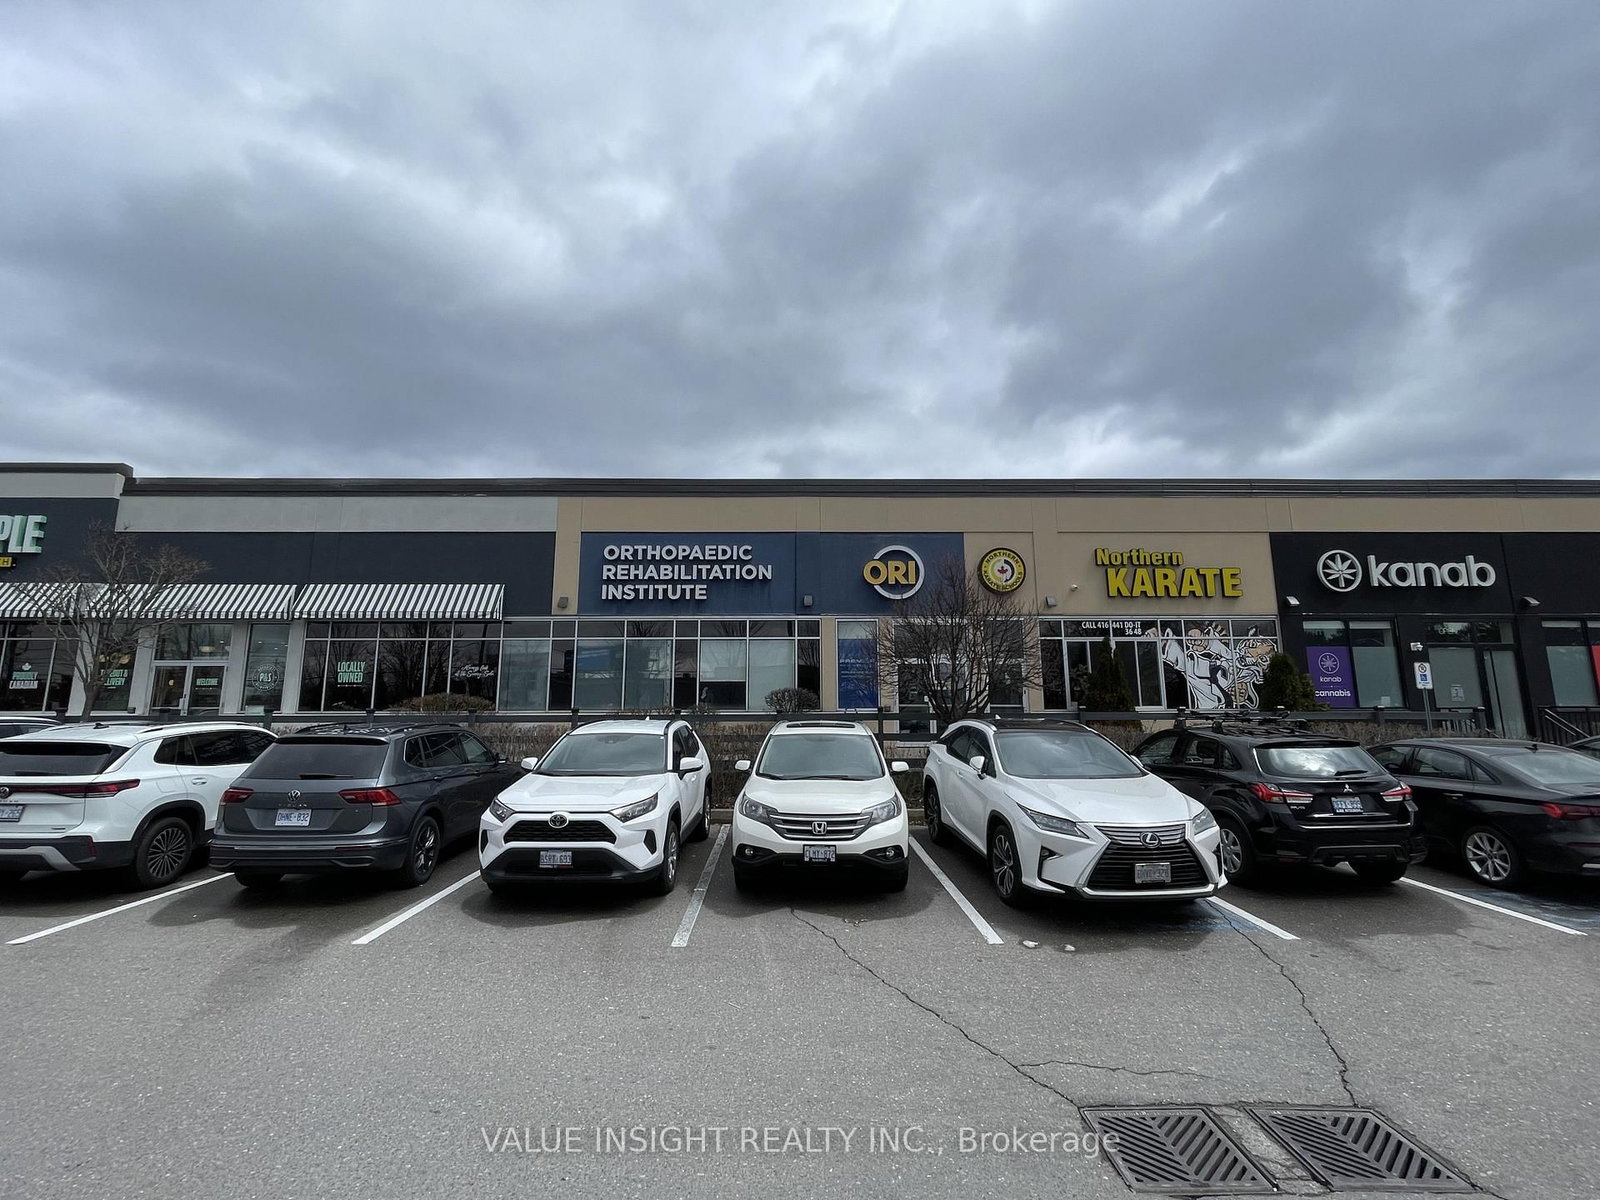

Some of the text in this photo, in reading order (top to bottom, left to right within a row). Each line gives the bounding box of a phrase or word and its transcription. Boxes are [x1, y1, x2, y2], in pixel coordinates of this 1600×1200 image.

[603, 545, 752, 560] ORTHOPAEDIC
[985, 552, 1020, 565] NORTHERN
[1096, 548, 1184, 566] Northern
[602, 565, 772, 580] REHABILITATION
[863, 560, 916, 585] ORI
[1367, 555, 1496, 587] kanab
[1107, 567, 1243, 597] KARATE
[601, 584, 707, 600] INSTITUTE
[1081, 621, 1097, 629] CALL
[1097, 621, 1109, 629] 416
[1112, 621, 1123, 629] 441
[337, 661, 366, 672] LOCALLY
[337, 672, 364, 683] OWNED
[1315, 689, 1351, 697] cannabis
